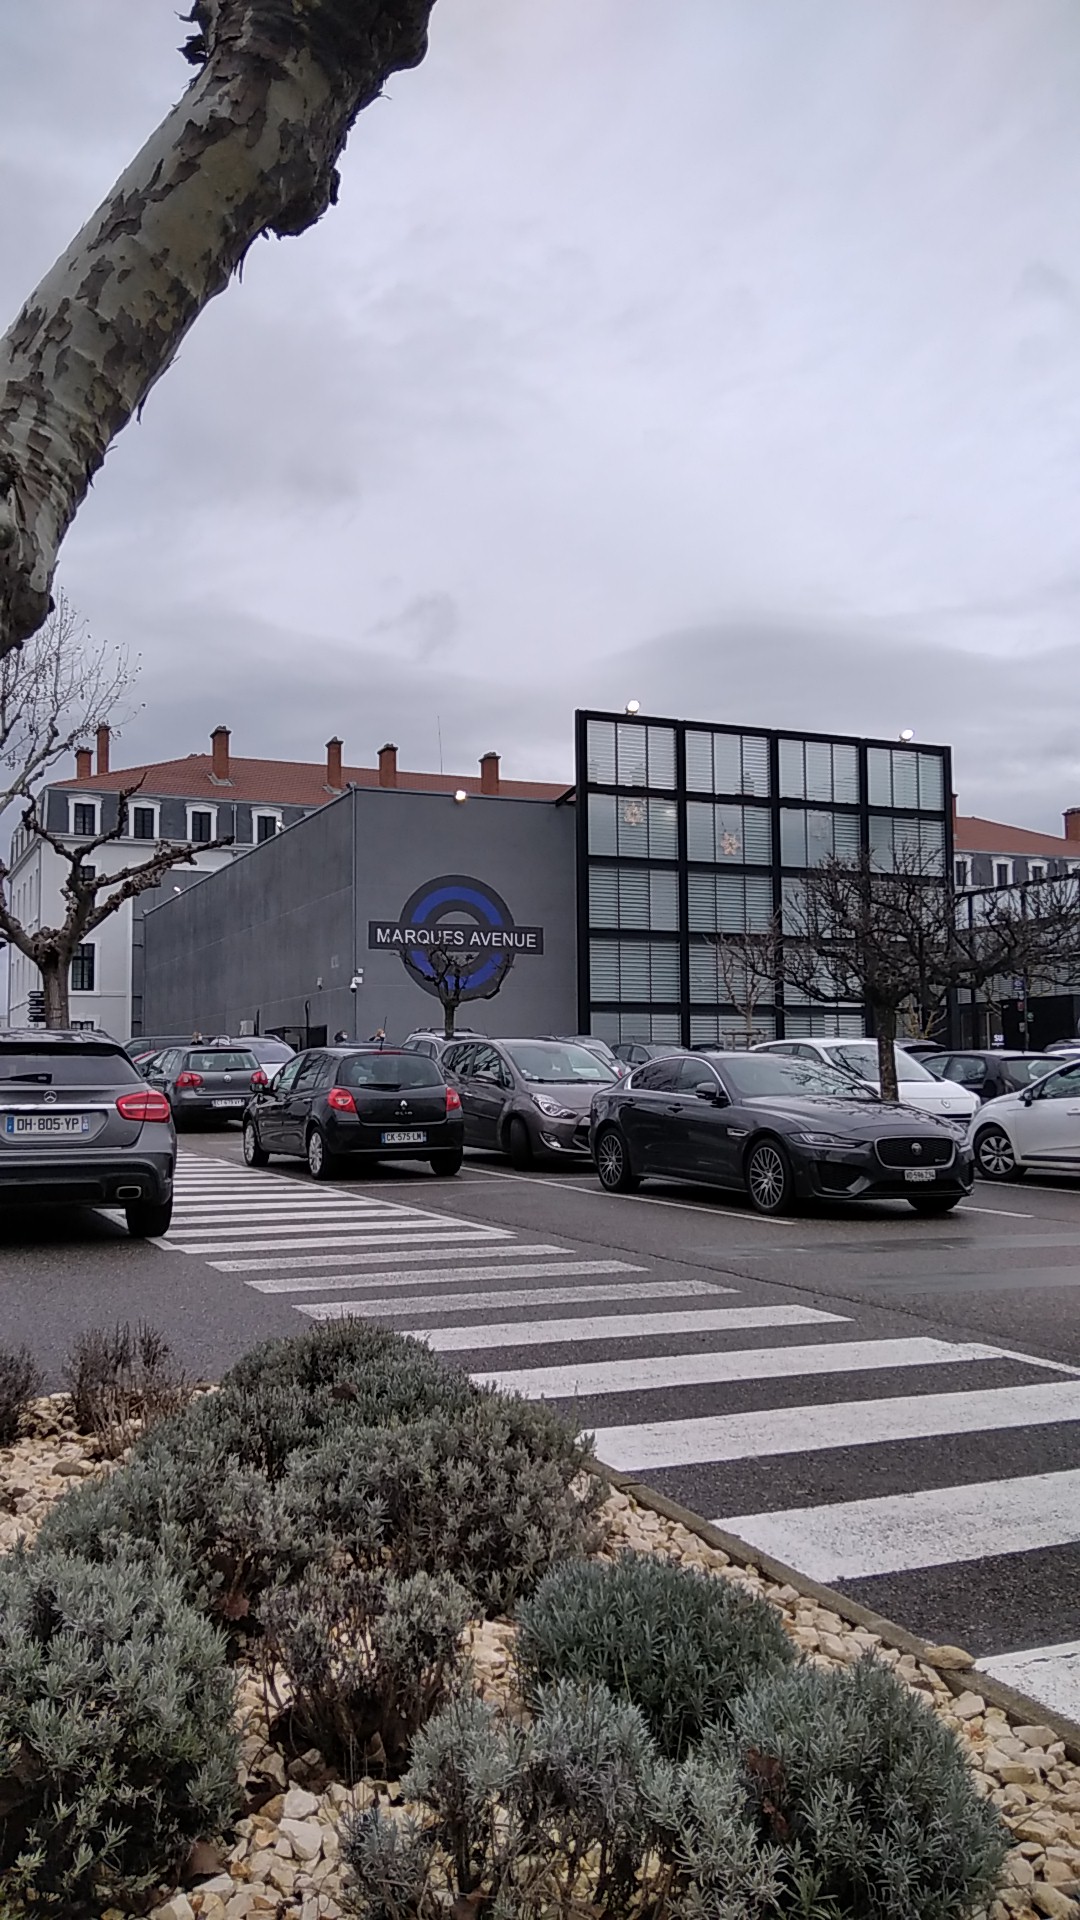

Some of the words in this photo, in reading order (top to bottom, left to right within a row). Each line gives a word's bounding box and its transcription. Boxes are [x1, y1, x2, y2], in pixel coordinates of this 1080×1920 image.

[376, 928, 464, 946] MARQUES
[470, 931, 537, 948] AVENUE
[16, 1118, 79, 1130] DH-805-YP
